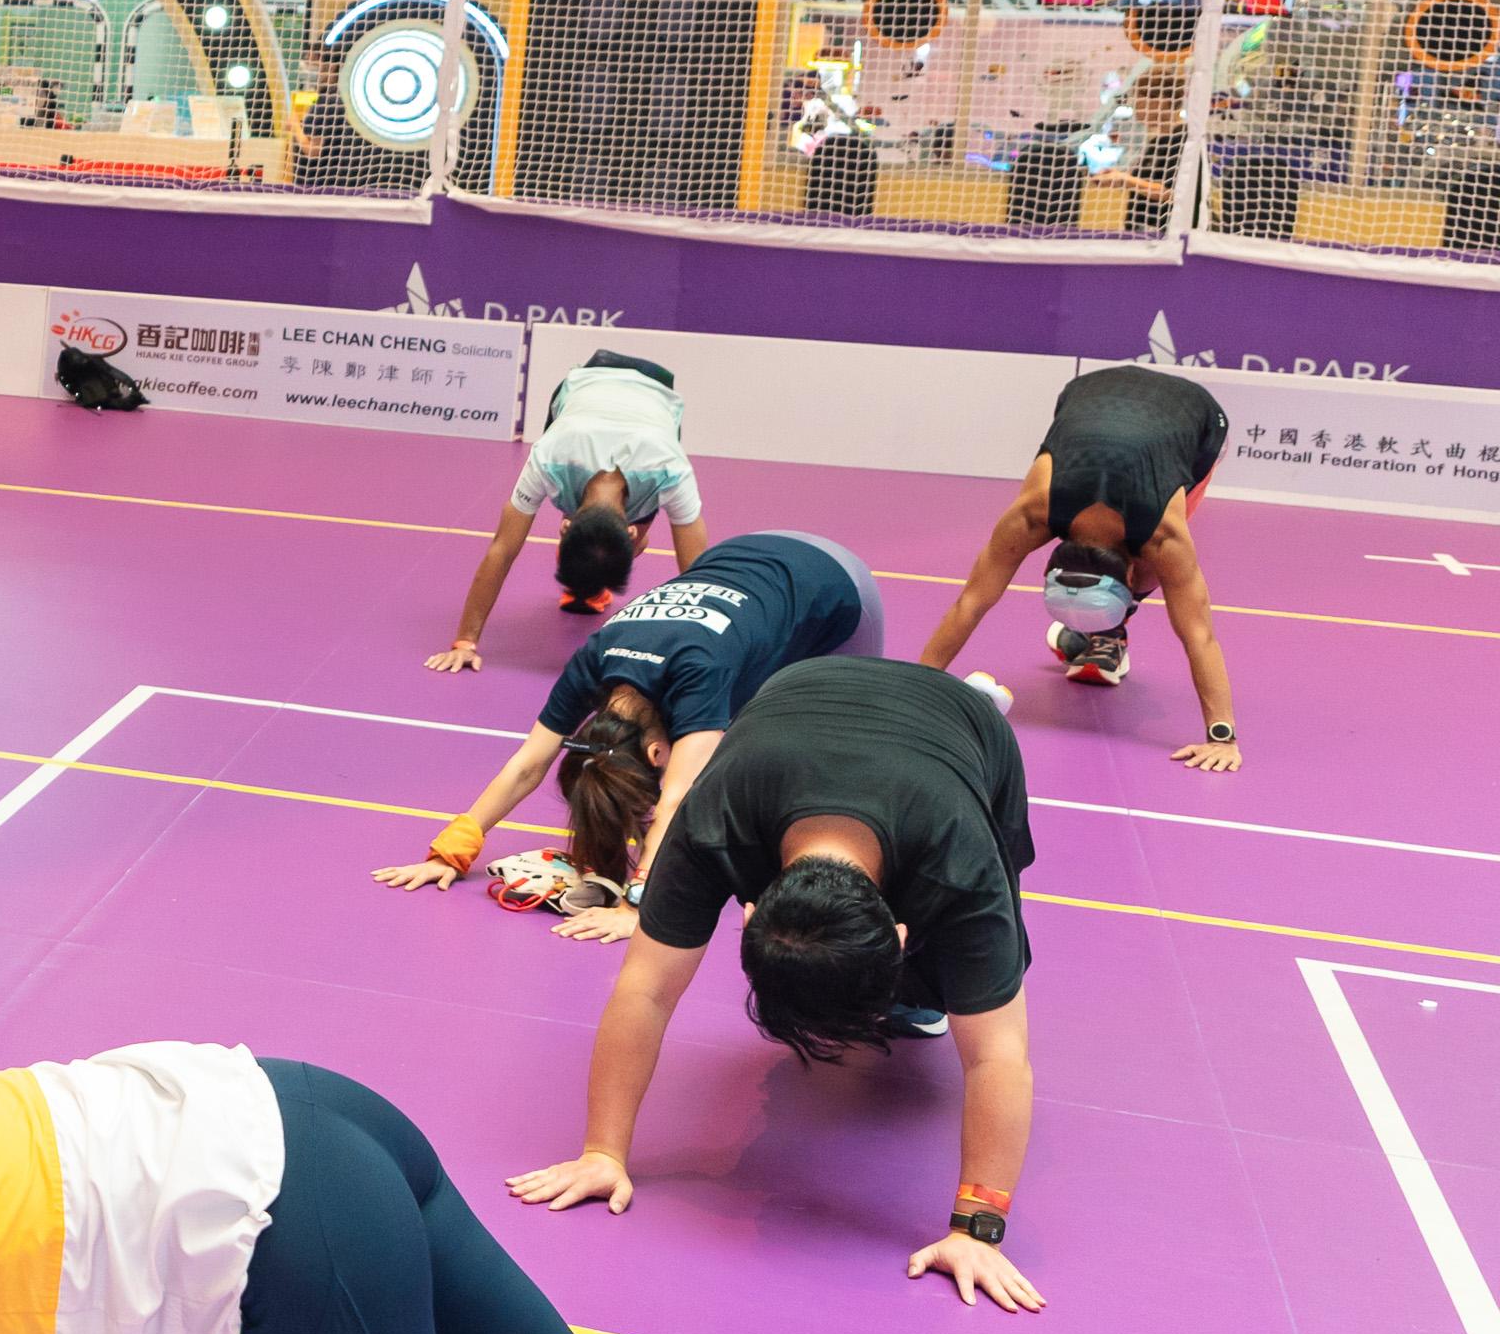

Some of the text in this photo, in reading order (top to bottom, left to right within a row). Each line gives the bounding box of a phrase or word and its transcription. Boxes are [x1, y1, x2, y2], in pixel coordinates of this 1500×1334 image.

[282, 327, 514, 360] LEE CHAN CHENG Solicitors
[186, 354, 223, 366] COFFEE
[225, 357, 260, 368] GROUP
[285, 392, 499, 422] www.leechancheng.com
[1236, 445, 1500, 483] Floorball Federation of Hong
[665, 606, 708, 620] GO
